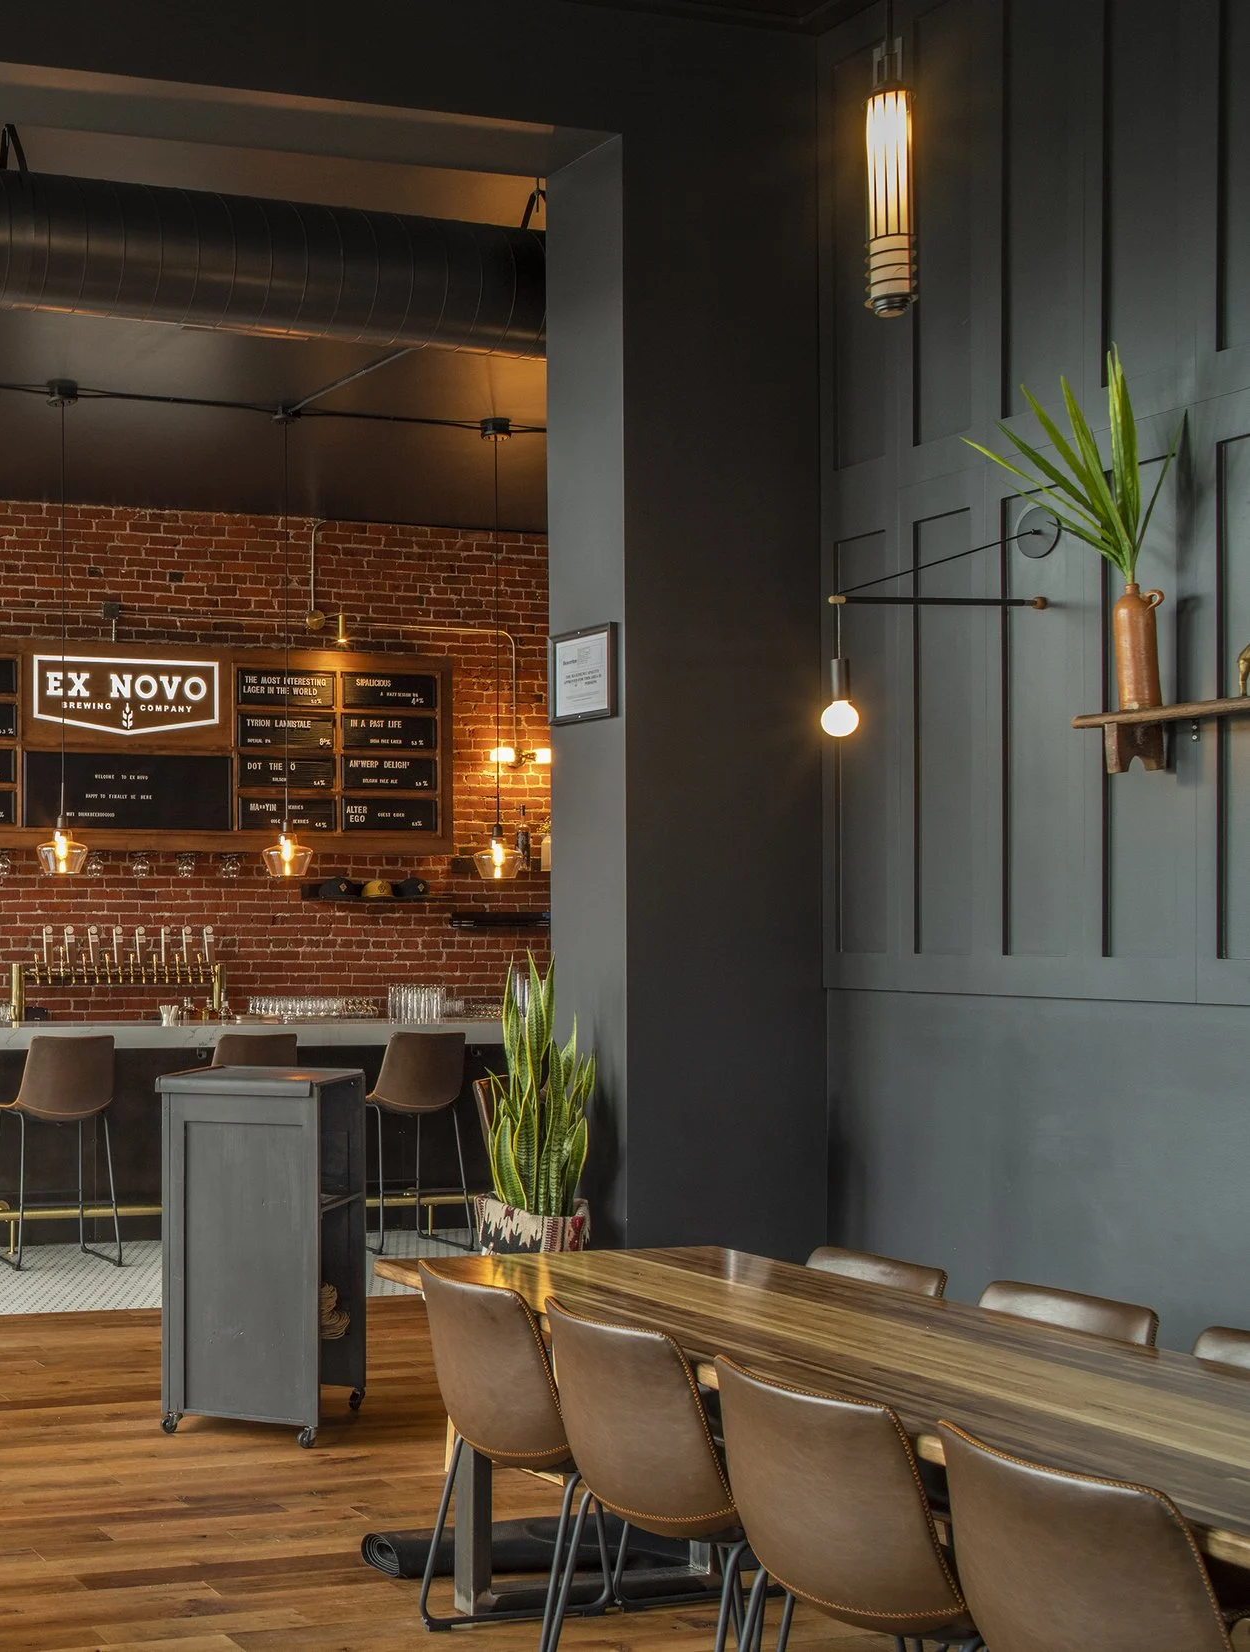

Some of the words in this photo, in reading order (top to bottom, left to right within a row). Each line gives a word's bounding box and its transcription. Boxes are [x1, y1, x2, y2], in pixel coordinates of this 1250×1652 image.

[46, 671, 90, 697] EX
[110, 674, 207, 700] NOVO
[245, 676, 258, 684] THE
[261, 676, 281, 685] MOST
[284, 677, 326, 687] INTERESTING
[356, 678, 392, 687] SIPALICIOUS
[243, 685, 265, 694] LAGER
[267, 686, 274, 694] IN
[276, 687, 290, 695] THE
[293, 687, 318, 696] WORLD
[62, 701, 112, 710] BREWING
[139, 704, 192, 713] COMPANY
[246, 718, 270, 727] TYRION
[350, 719, 358, 727] IN
[369, 720, 385, 728] PAST
[388, 720, 402, 728] LIFE
[247, 762, 262, 770] DOT
[349, 760, 379, 768] ANTWERP
[383, 761, 410, 769] DELIGHT
[346, 806, 368, 814] ALTER
[349, 814, 365, 823] EGO
